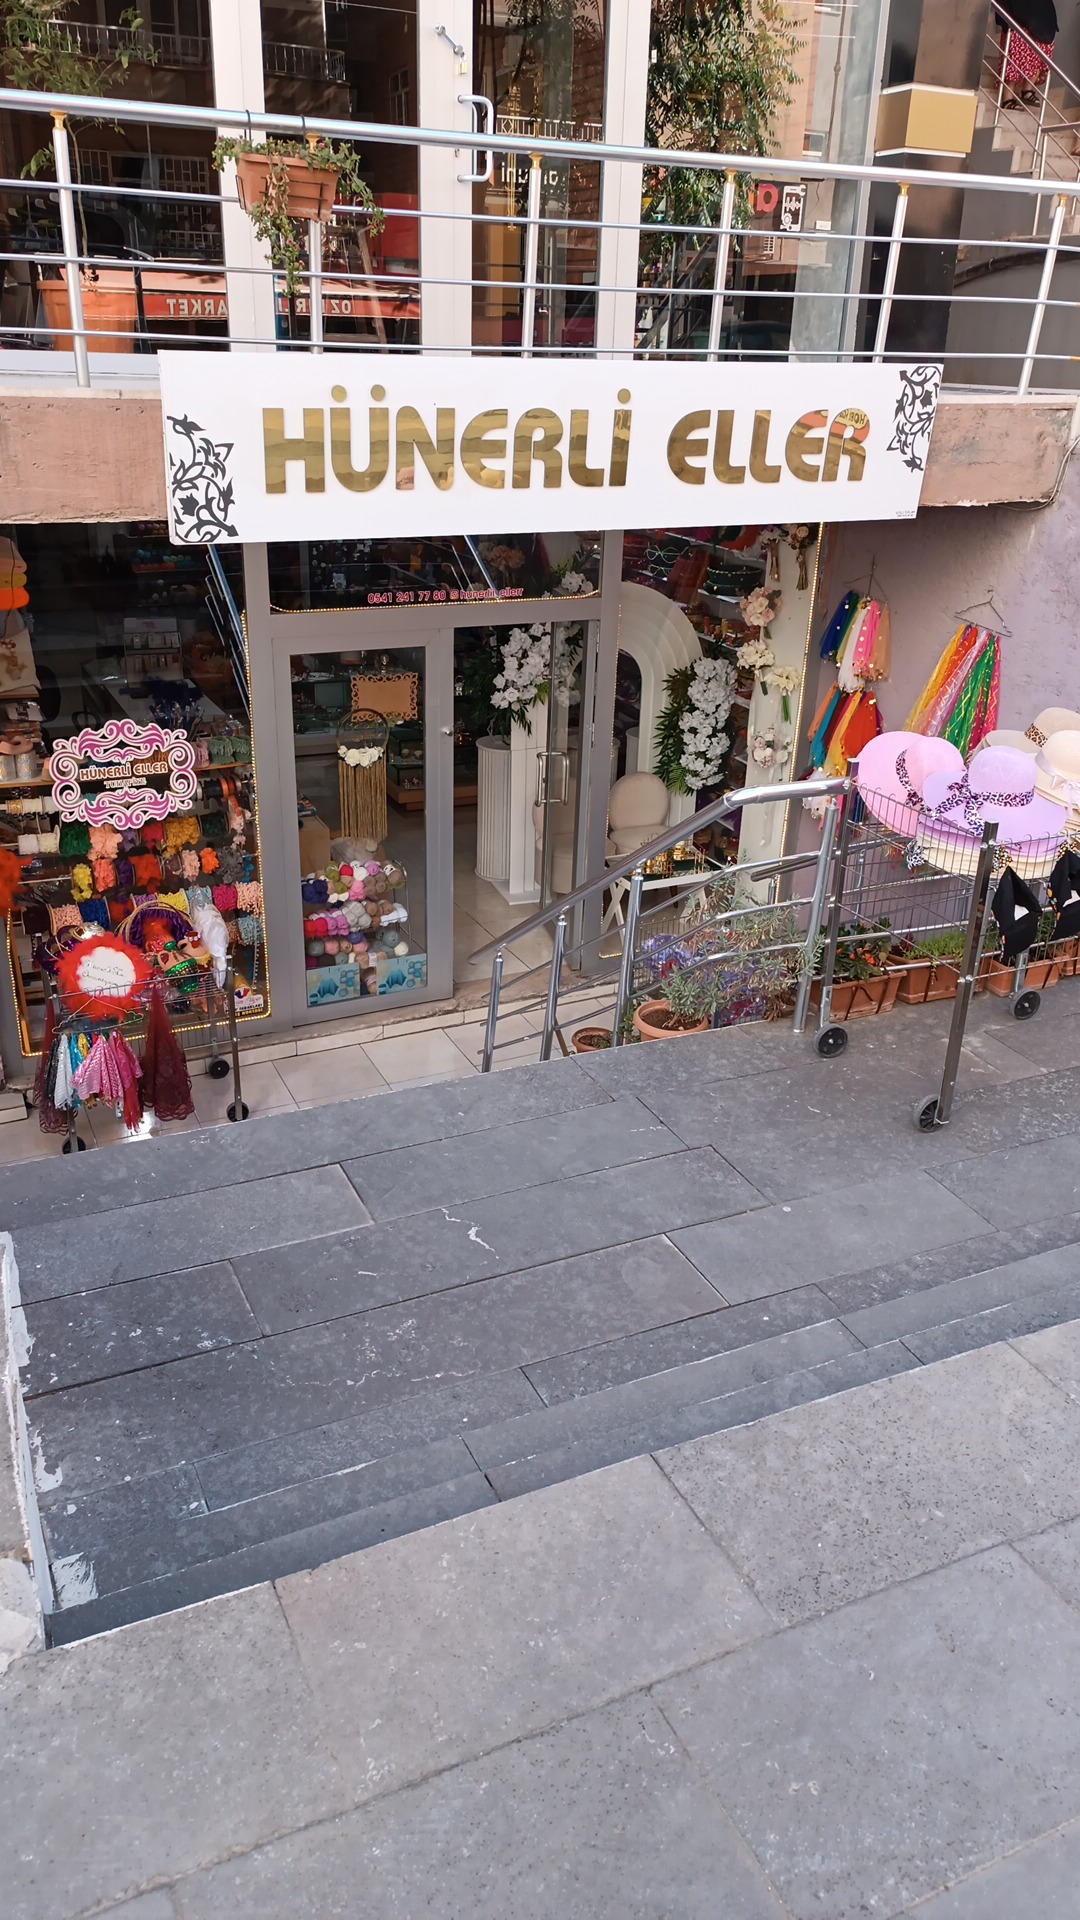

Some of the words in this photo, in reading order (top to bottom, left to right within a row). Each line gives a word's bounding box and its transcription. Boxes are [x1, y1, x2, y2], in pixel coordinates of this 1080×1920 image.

[262, 384, 632, 494] HÜNERLİ
[667, 408, 870, 485] ELLER
[367, 592, 393, 604] 0541
[396, 591, 415, 602] 241
[418, 590, 431, 601] 77
[433, 590, 447, 600] 80
[80, 763, 132, 780] HÜNERLİ
[133, 761, 168, 775] ELLER
